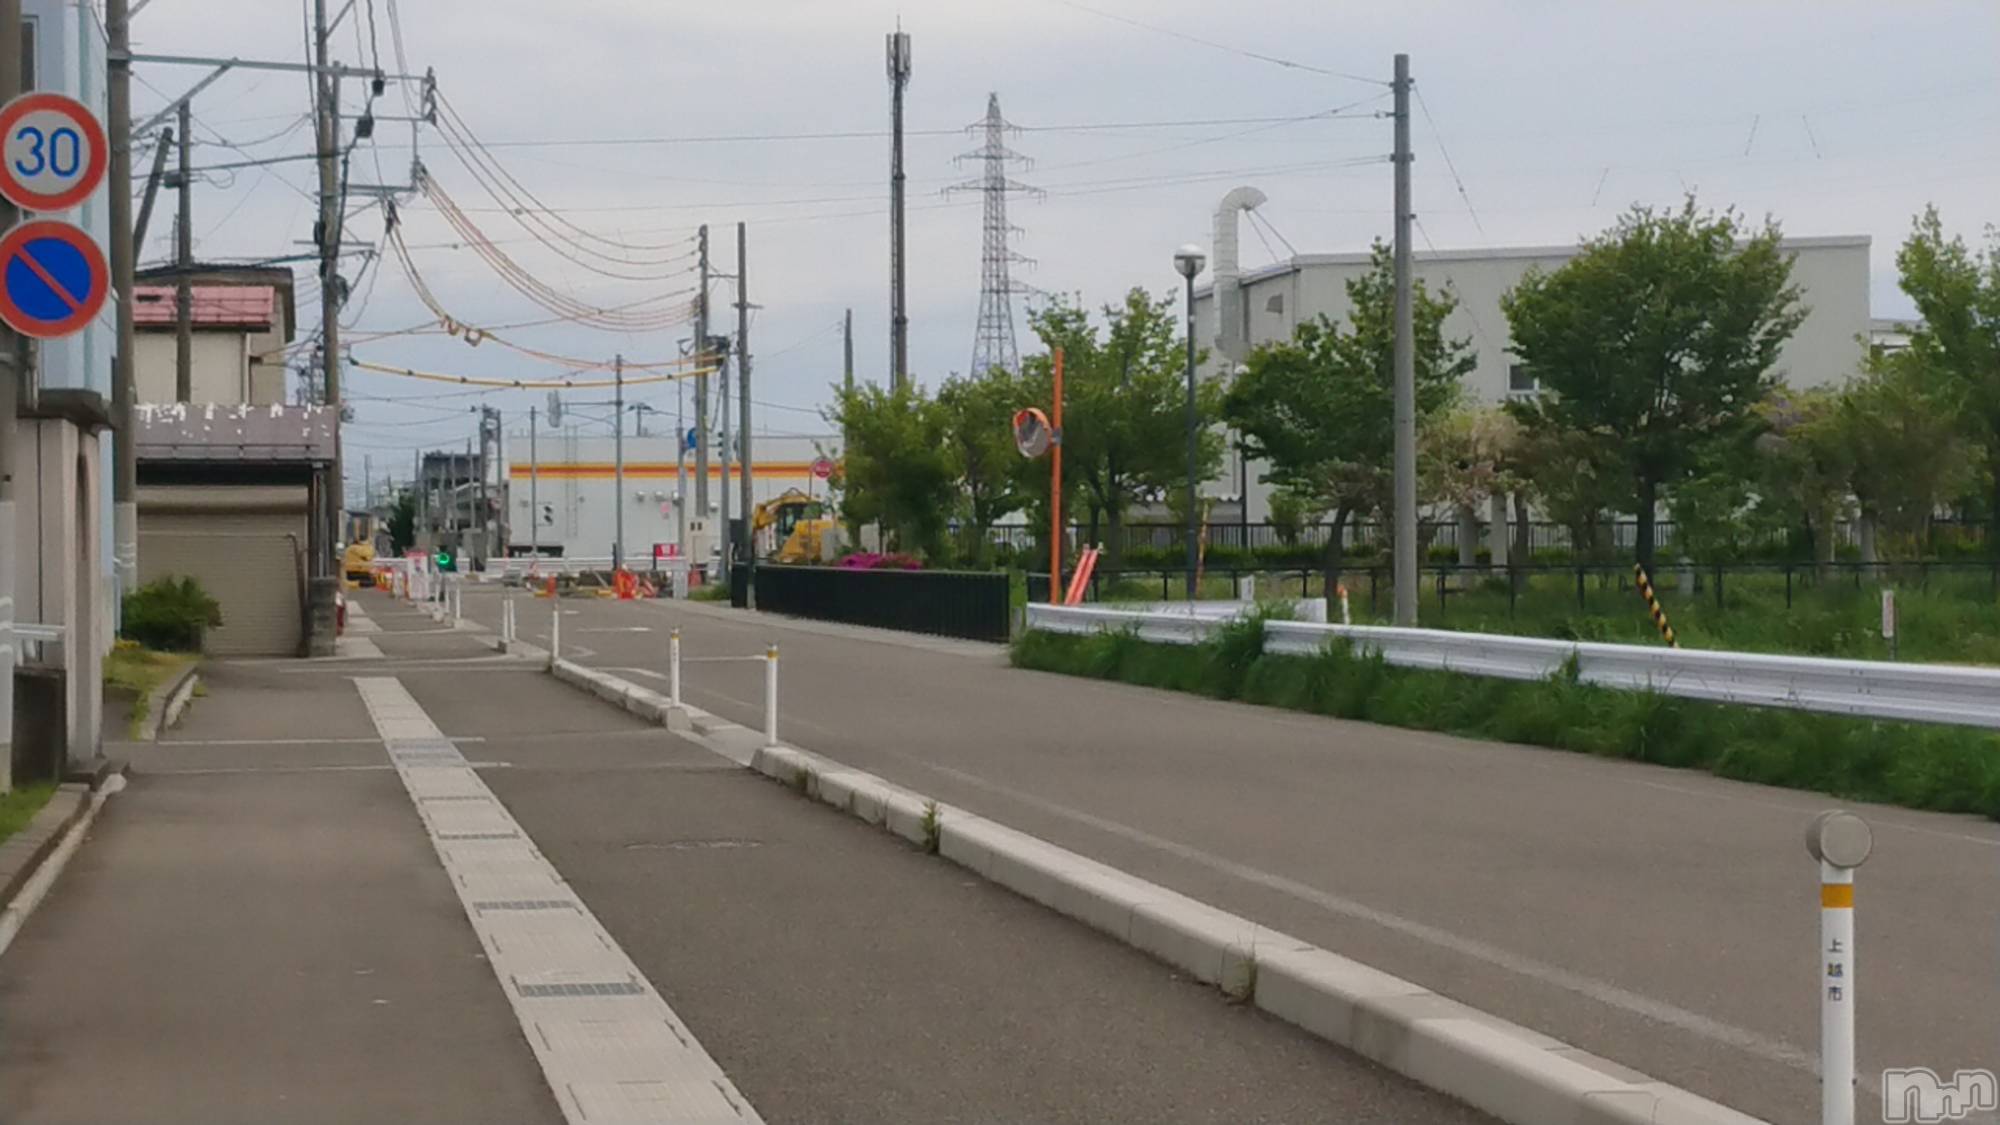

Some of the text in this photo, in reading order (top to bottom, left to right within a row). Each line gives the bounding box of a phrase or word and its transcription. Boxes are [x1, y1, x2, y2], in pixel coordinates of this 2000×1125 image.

[15, 126, 80, 178] 30
[1827, 938, 1843, 1002] 上越市
